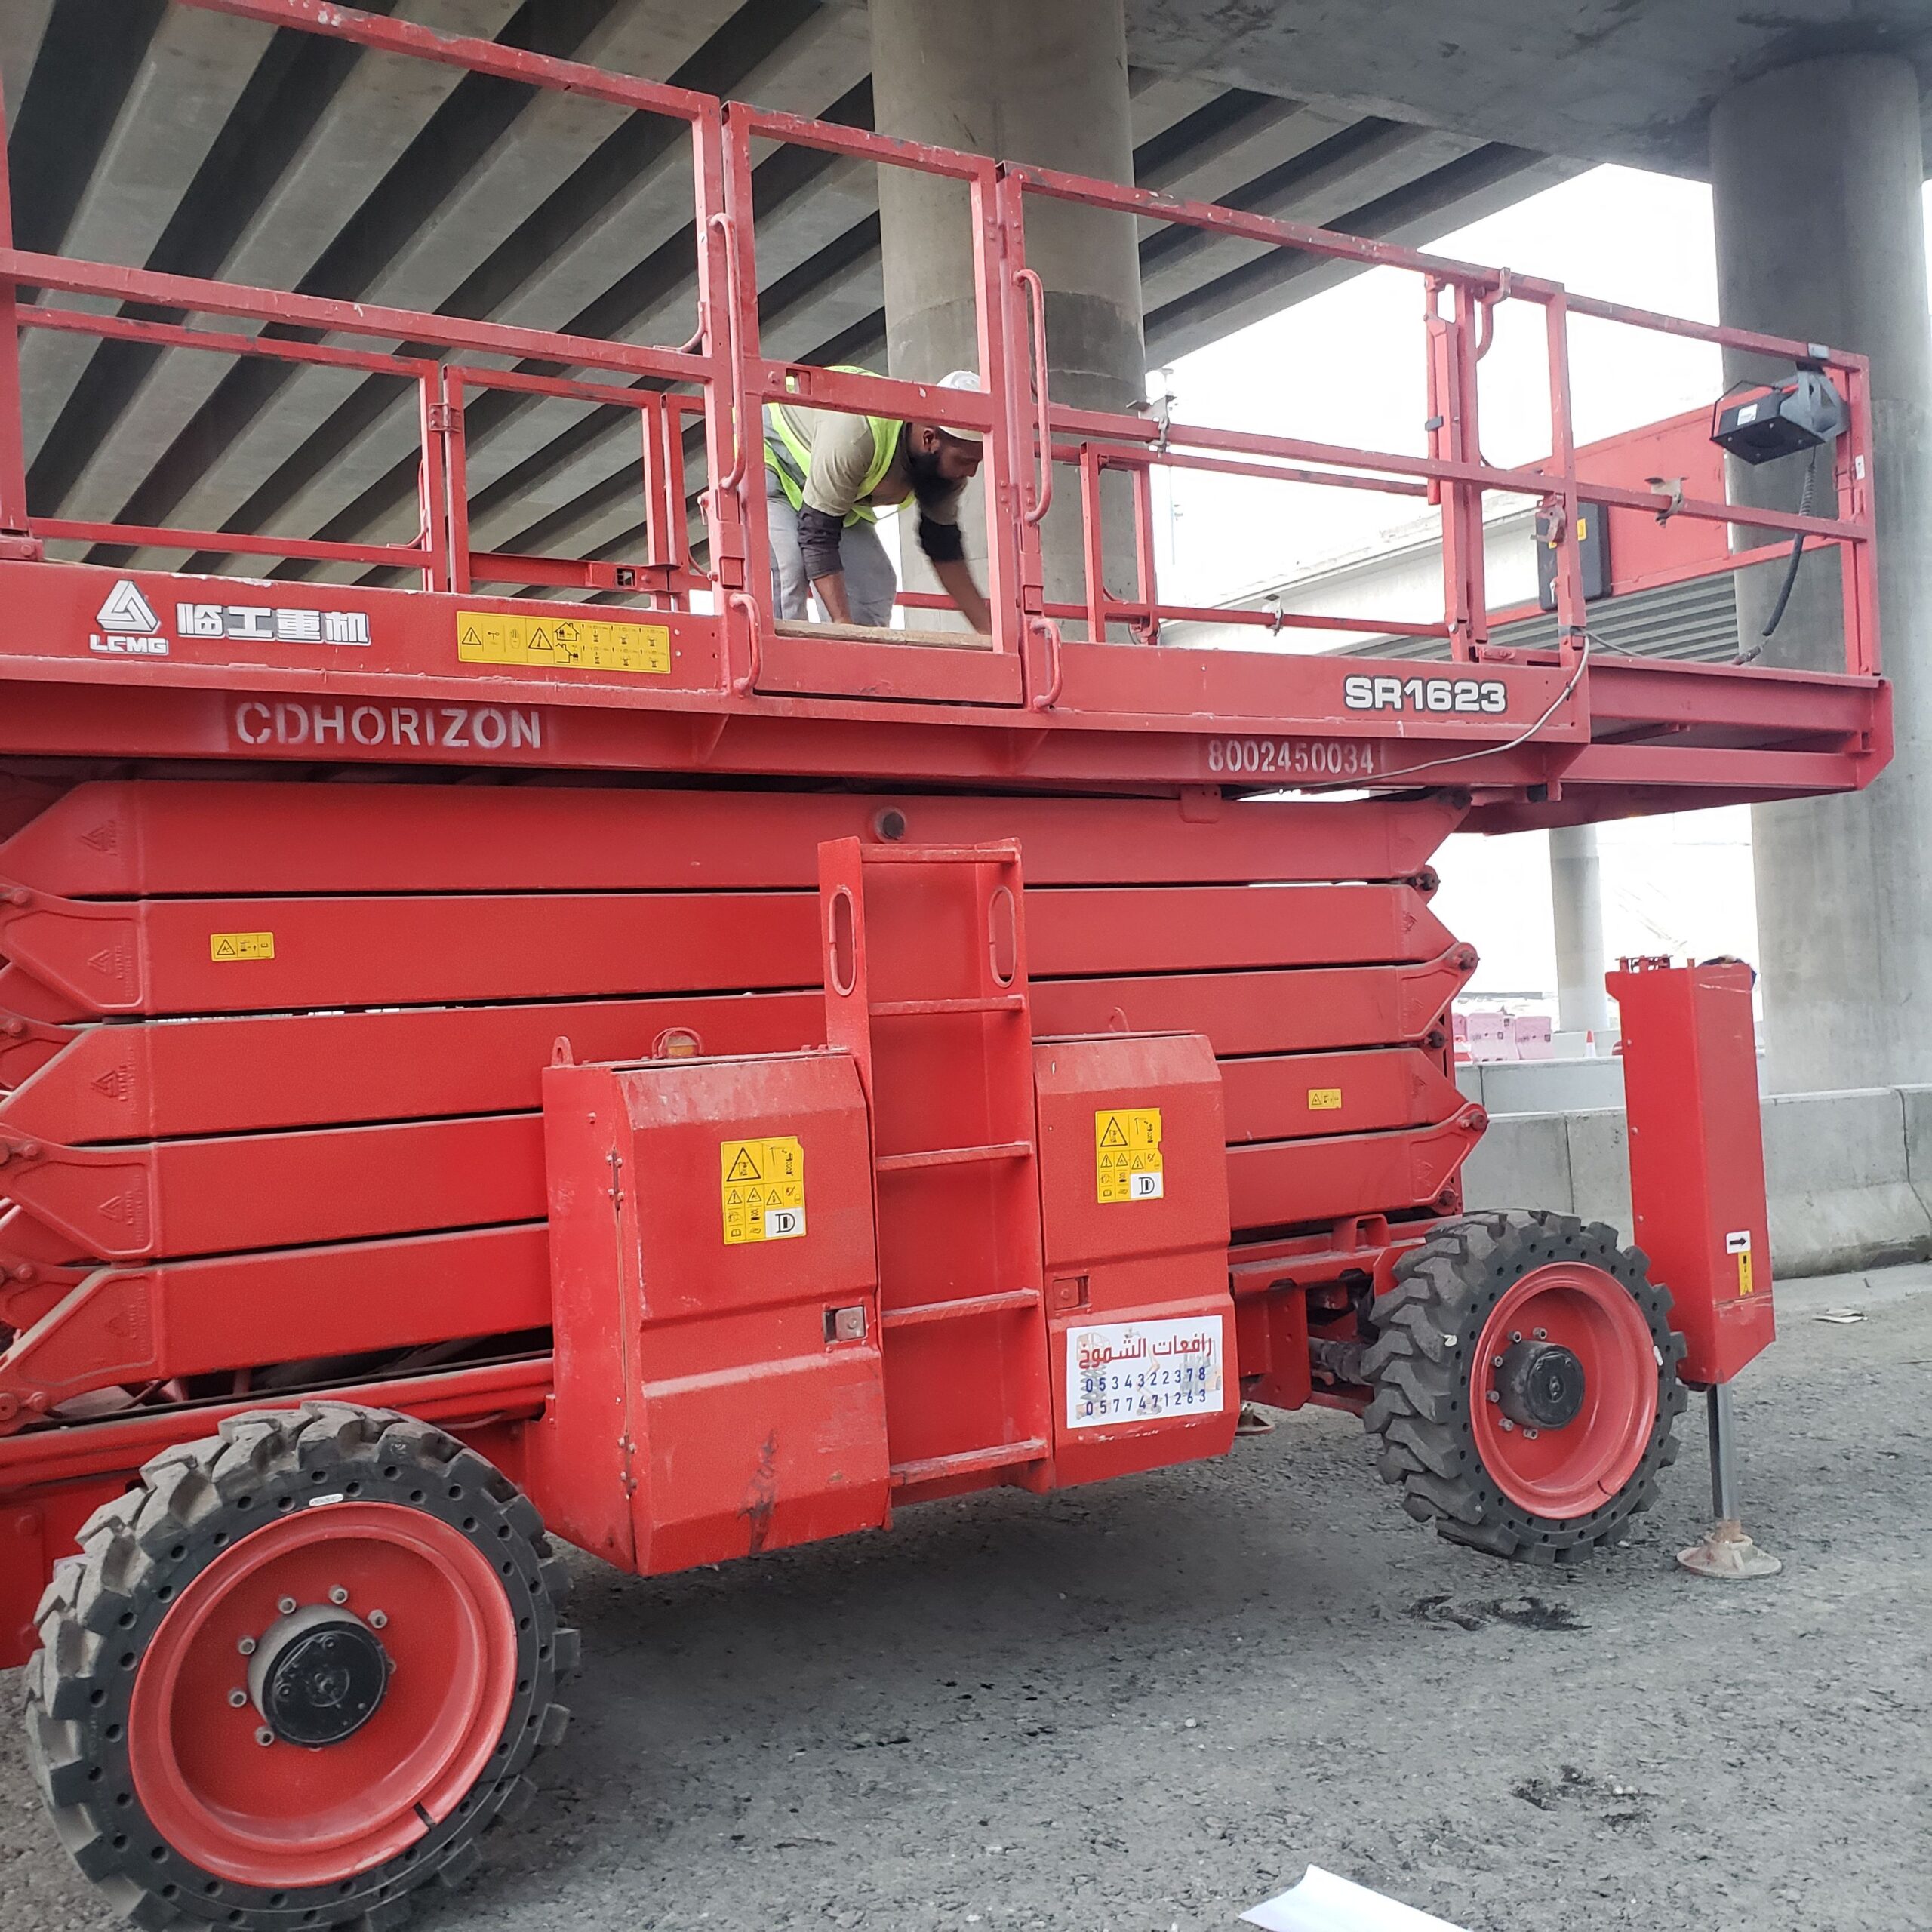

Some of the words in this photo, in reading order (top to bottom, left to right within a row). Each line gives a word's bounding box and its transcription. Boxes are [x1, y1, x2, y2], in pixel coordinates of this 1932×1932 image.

[177, 604, 369, 642] 临工重机
[1346, 677, 1506, 712] SR1623
[237, 703, 540, 749] CDHORIZON
[1208, 740, 1374, 774] 8002450034
[1078, 1337, 1146, 1370] الشموخ
[1152, 1332, 1212, 1357] رافعات
[1085, 1367, 1206, 1393] 0534322378
[1085, 1389, 1206, 1416] 0577471263
